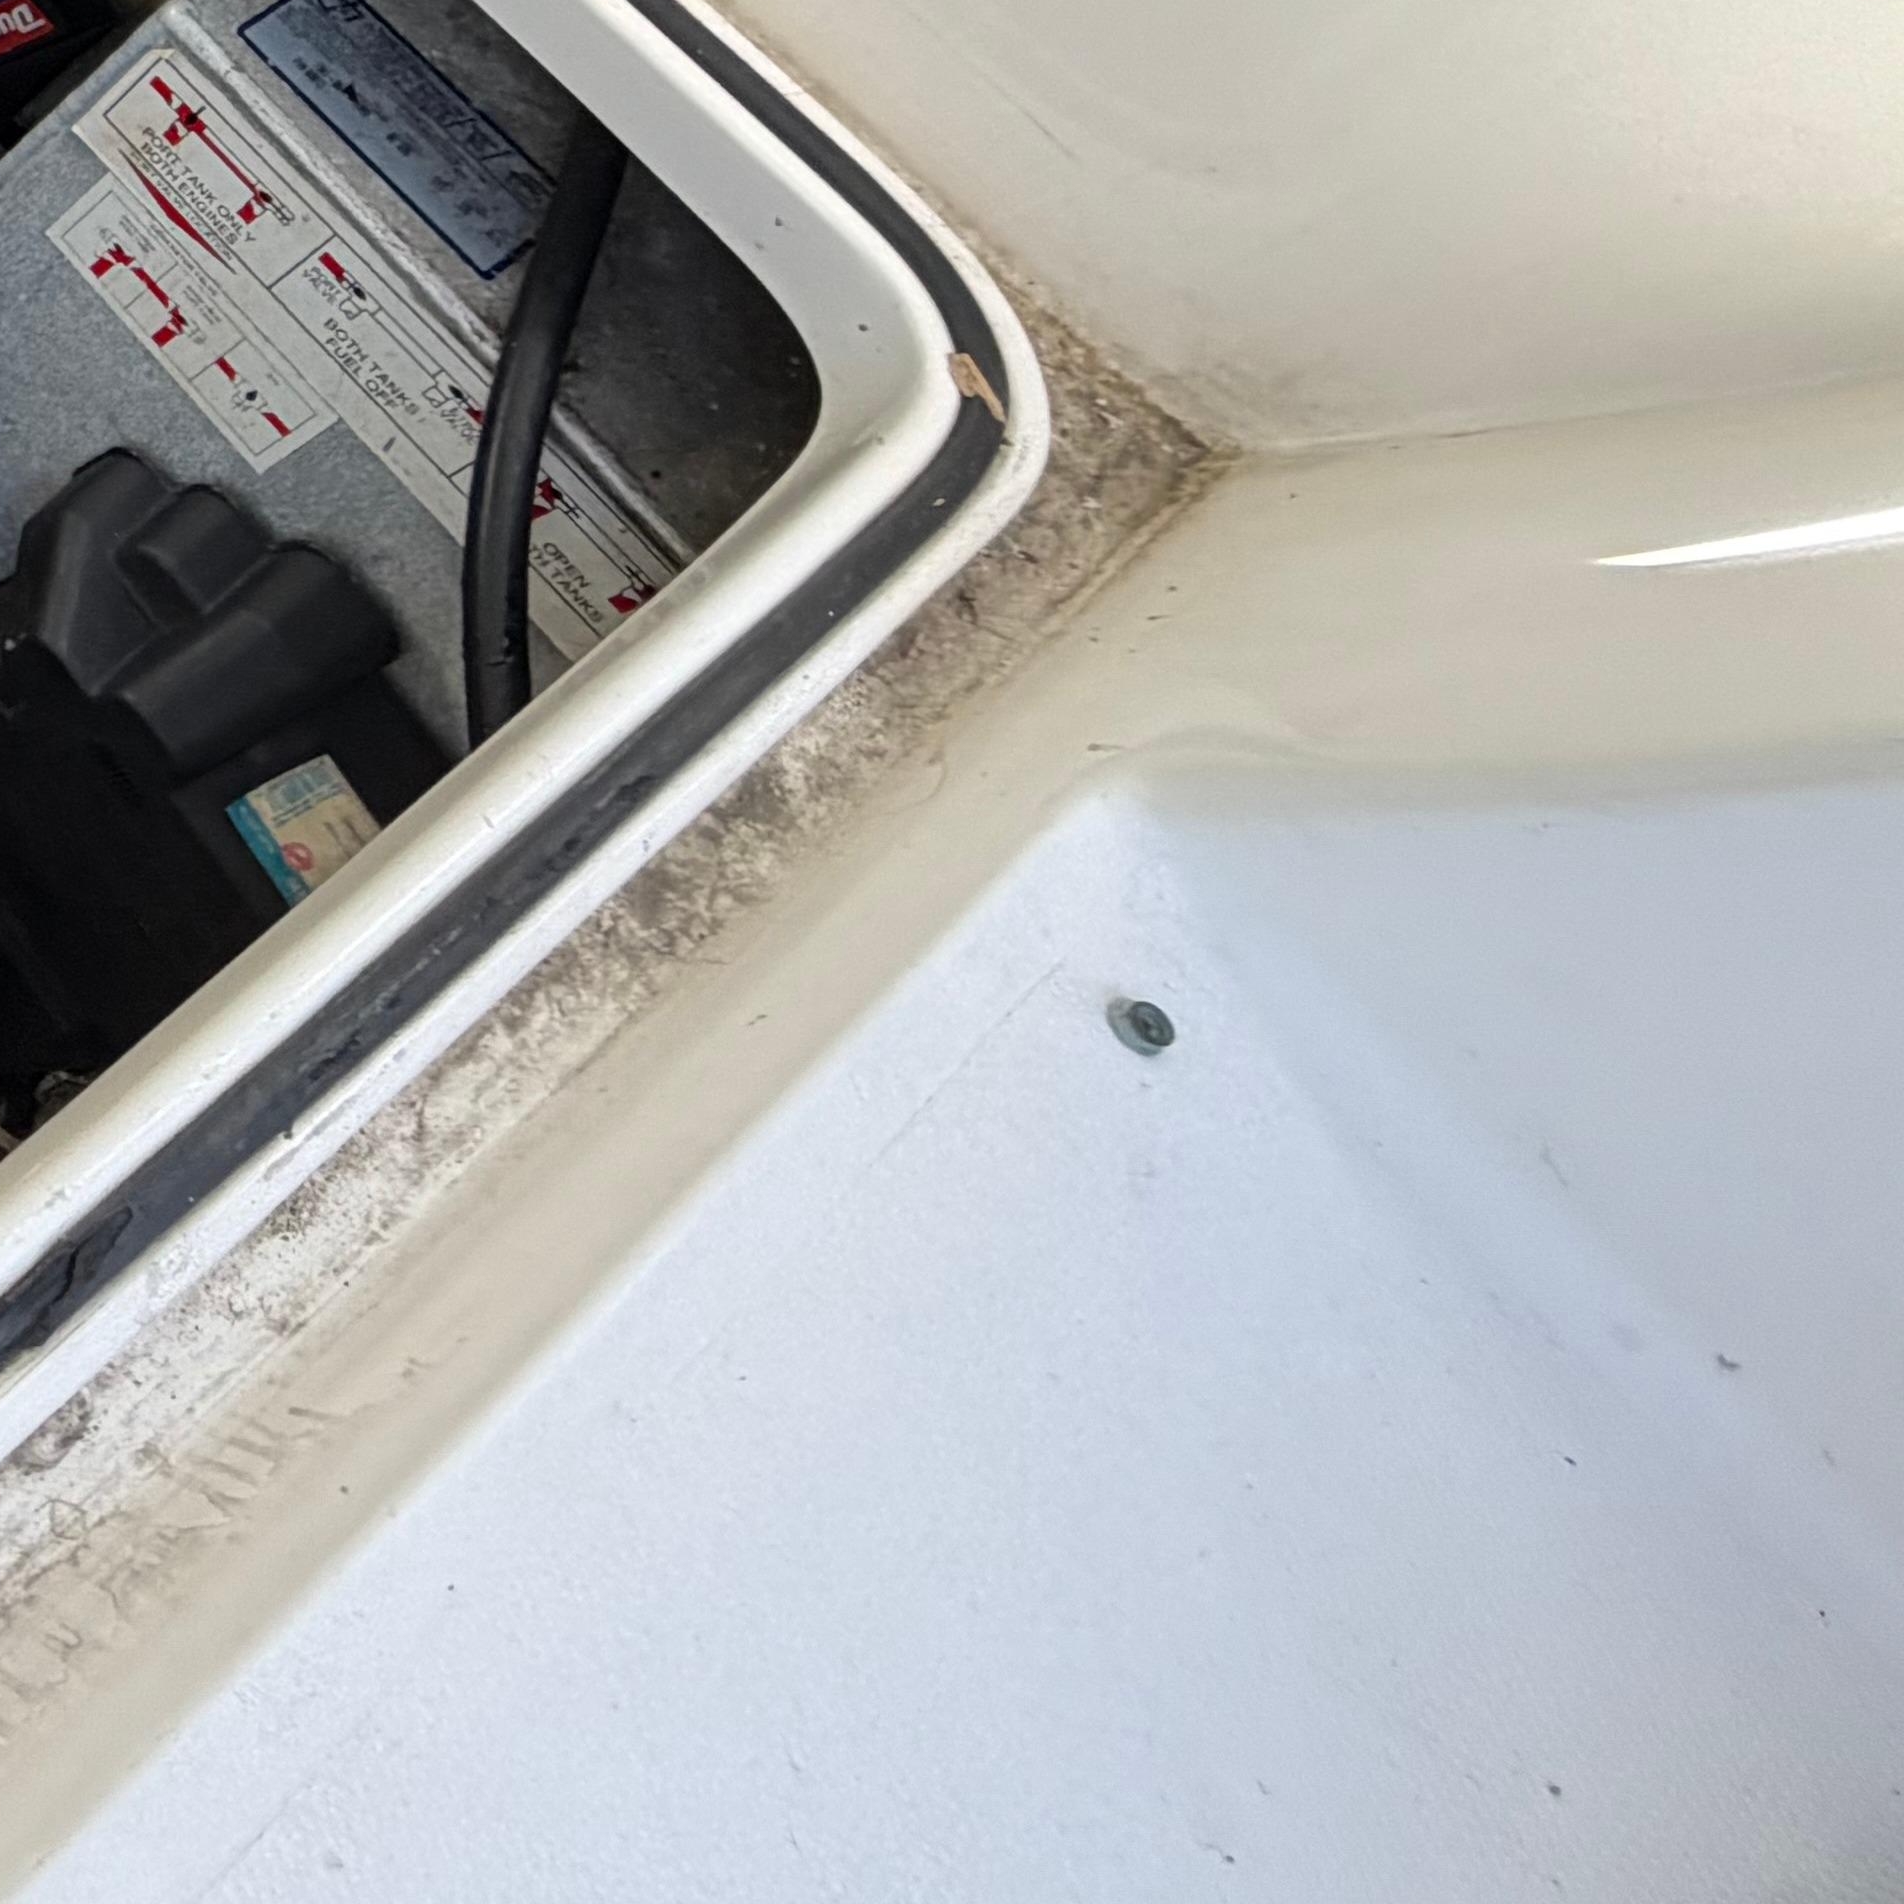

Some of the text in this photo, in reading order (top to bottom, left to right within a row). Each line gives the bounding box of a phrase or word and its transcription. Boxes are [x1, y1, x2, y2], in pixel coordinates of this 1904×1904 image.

[138, 141, 180, 184] BOTH
[176, 182, 238, 245] ENGINES
[141, 126, 256, 242] PORT TANK ONLY
[323, 316, 421, 418] BOTH TANKS
[324, 337, 398, 412] FUEL OFF
[541, 540, 591, 590] OPEN
[547, 568, 604, 624] TANKS
